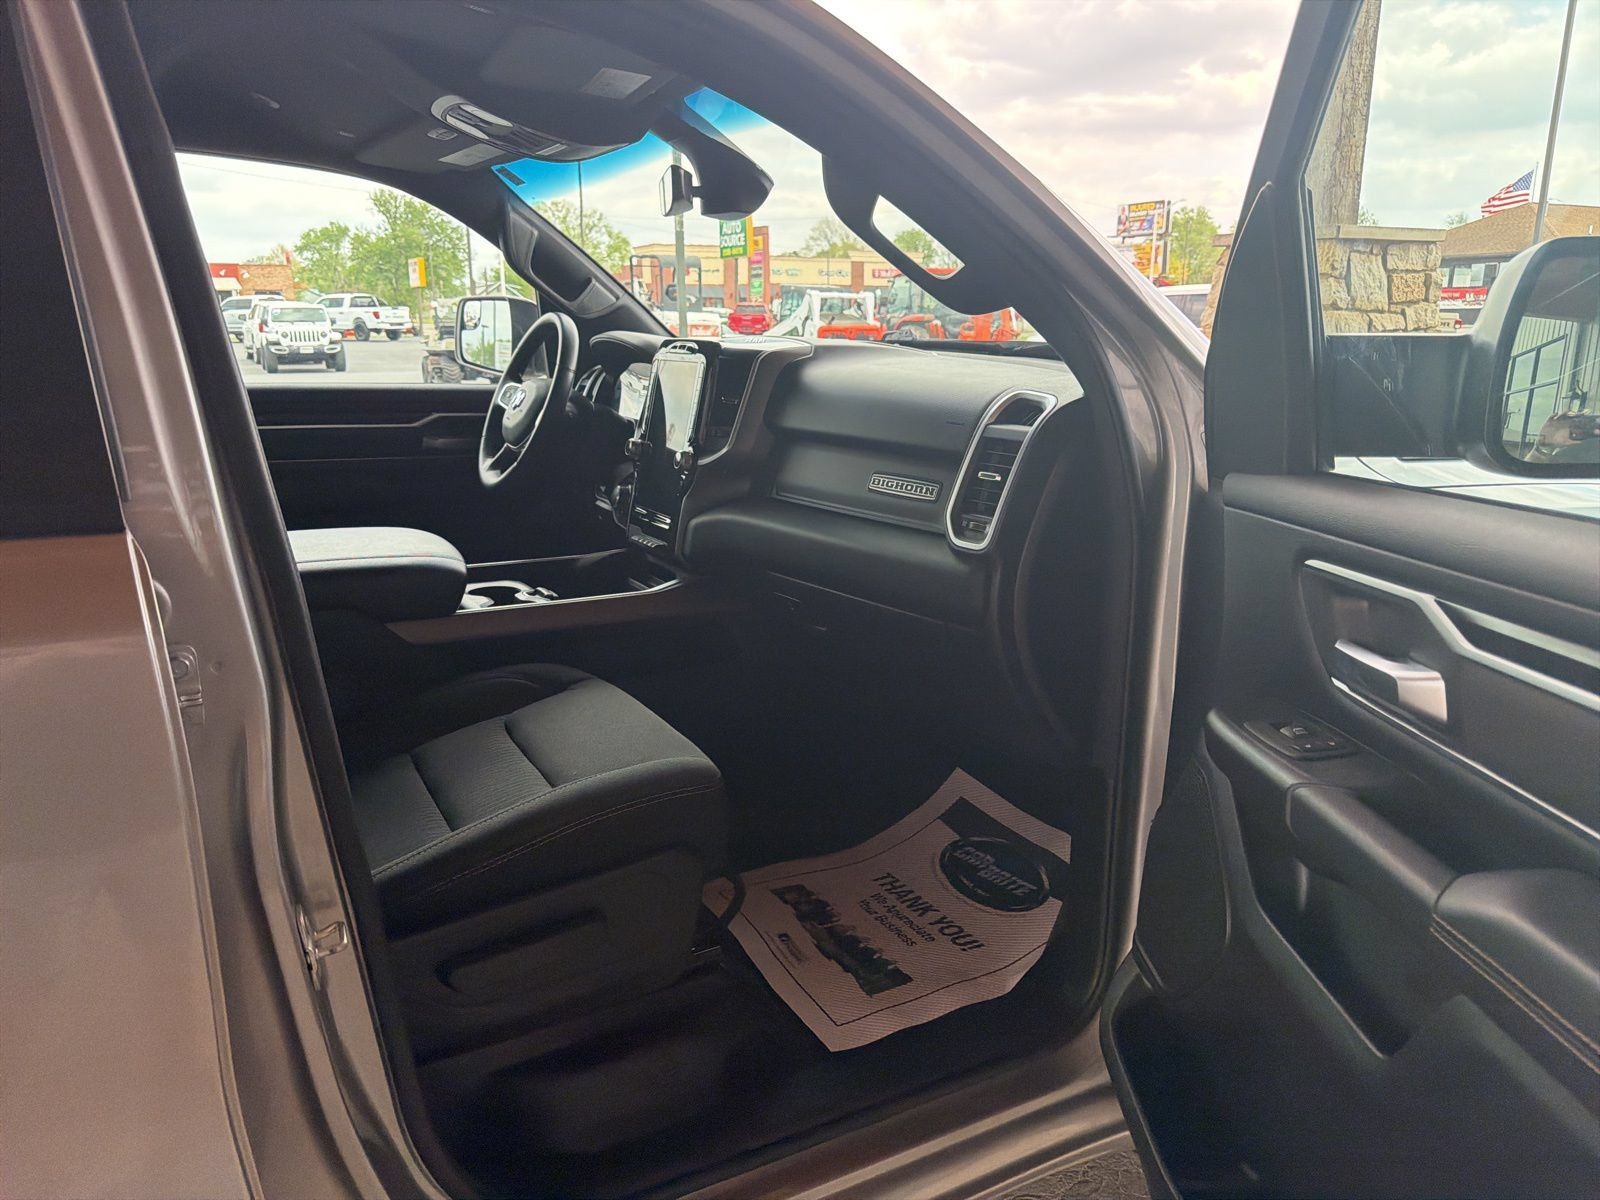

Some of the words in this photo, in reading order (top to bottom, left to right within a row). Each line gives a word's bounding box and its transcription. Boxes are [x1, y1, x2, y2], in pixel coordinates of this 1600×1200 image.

[722, 220, 742, 235] AUTO
[871, 477, 937, 497] BIGHORN
[870, 892, 888, 906] We
[872, 871, 941, 918] THANK
[874, 914, 918, 948] Business
